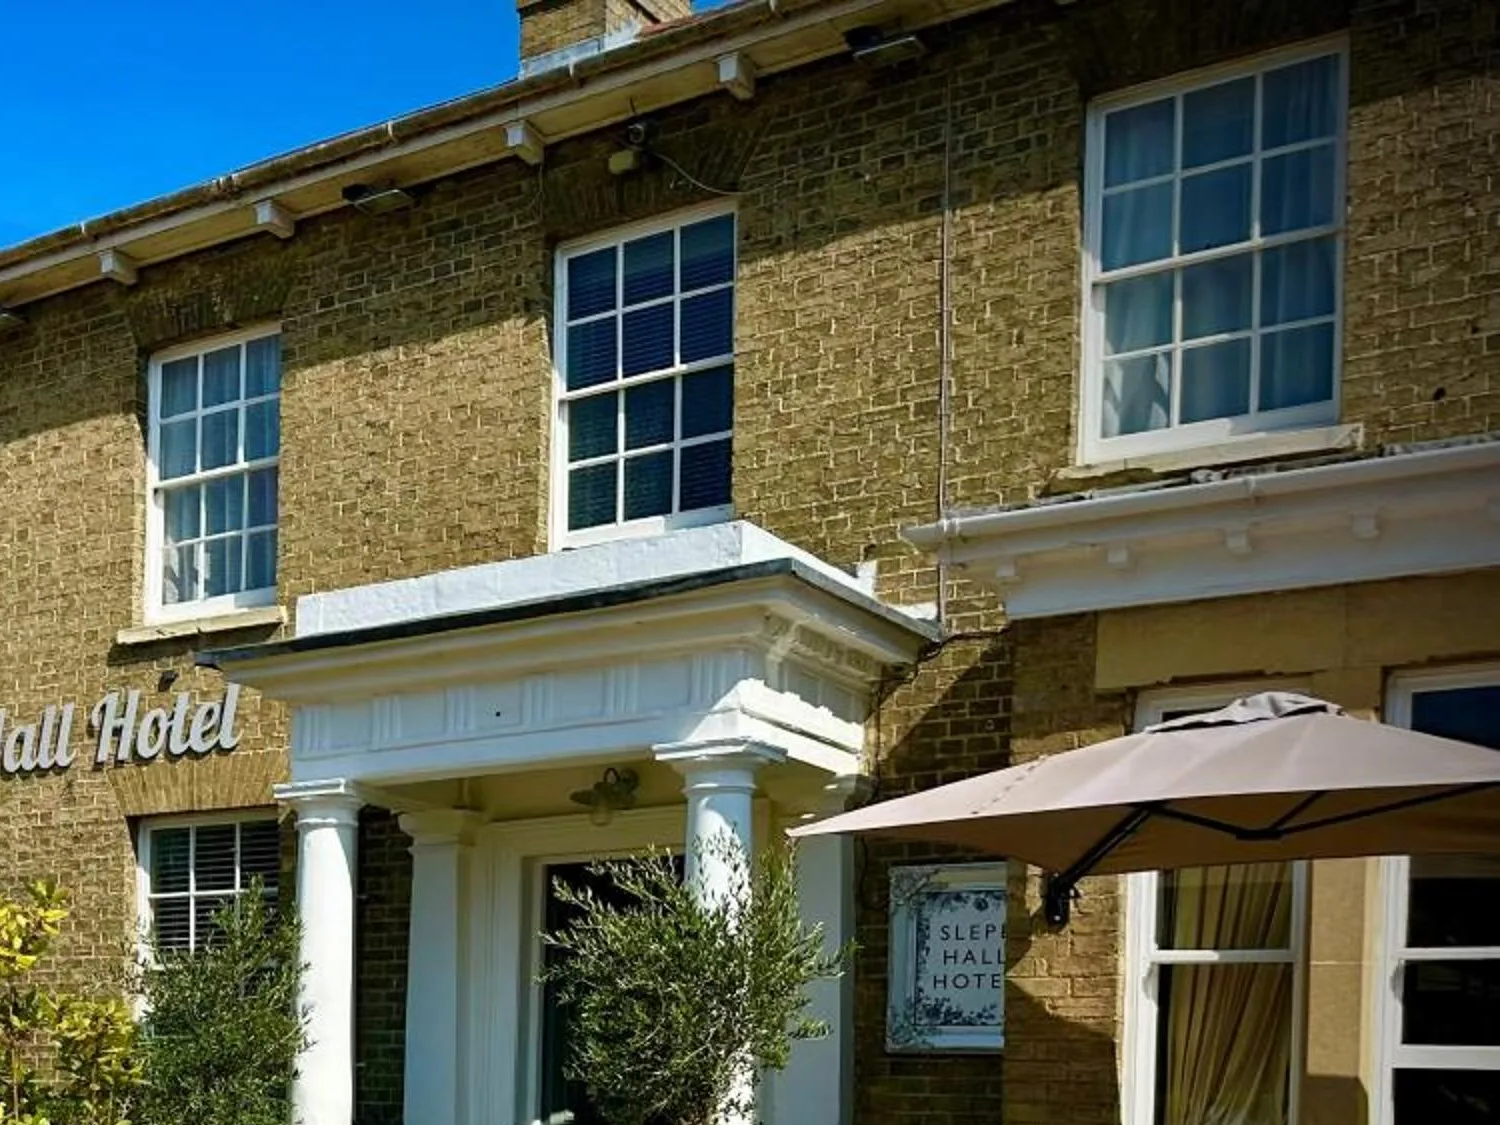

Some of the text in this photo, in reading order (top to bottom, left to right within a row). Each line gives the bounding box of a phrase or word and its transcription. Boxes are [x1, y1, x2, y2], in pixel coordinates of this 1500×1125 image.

[91, 682, 245, 764] Hotel
[943, 948, 1006, 965] HALL
[933, 973, 1001, 990] HOTE
